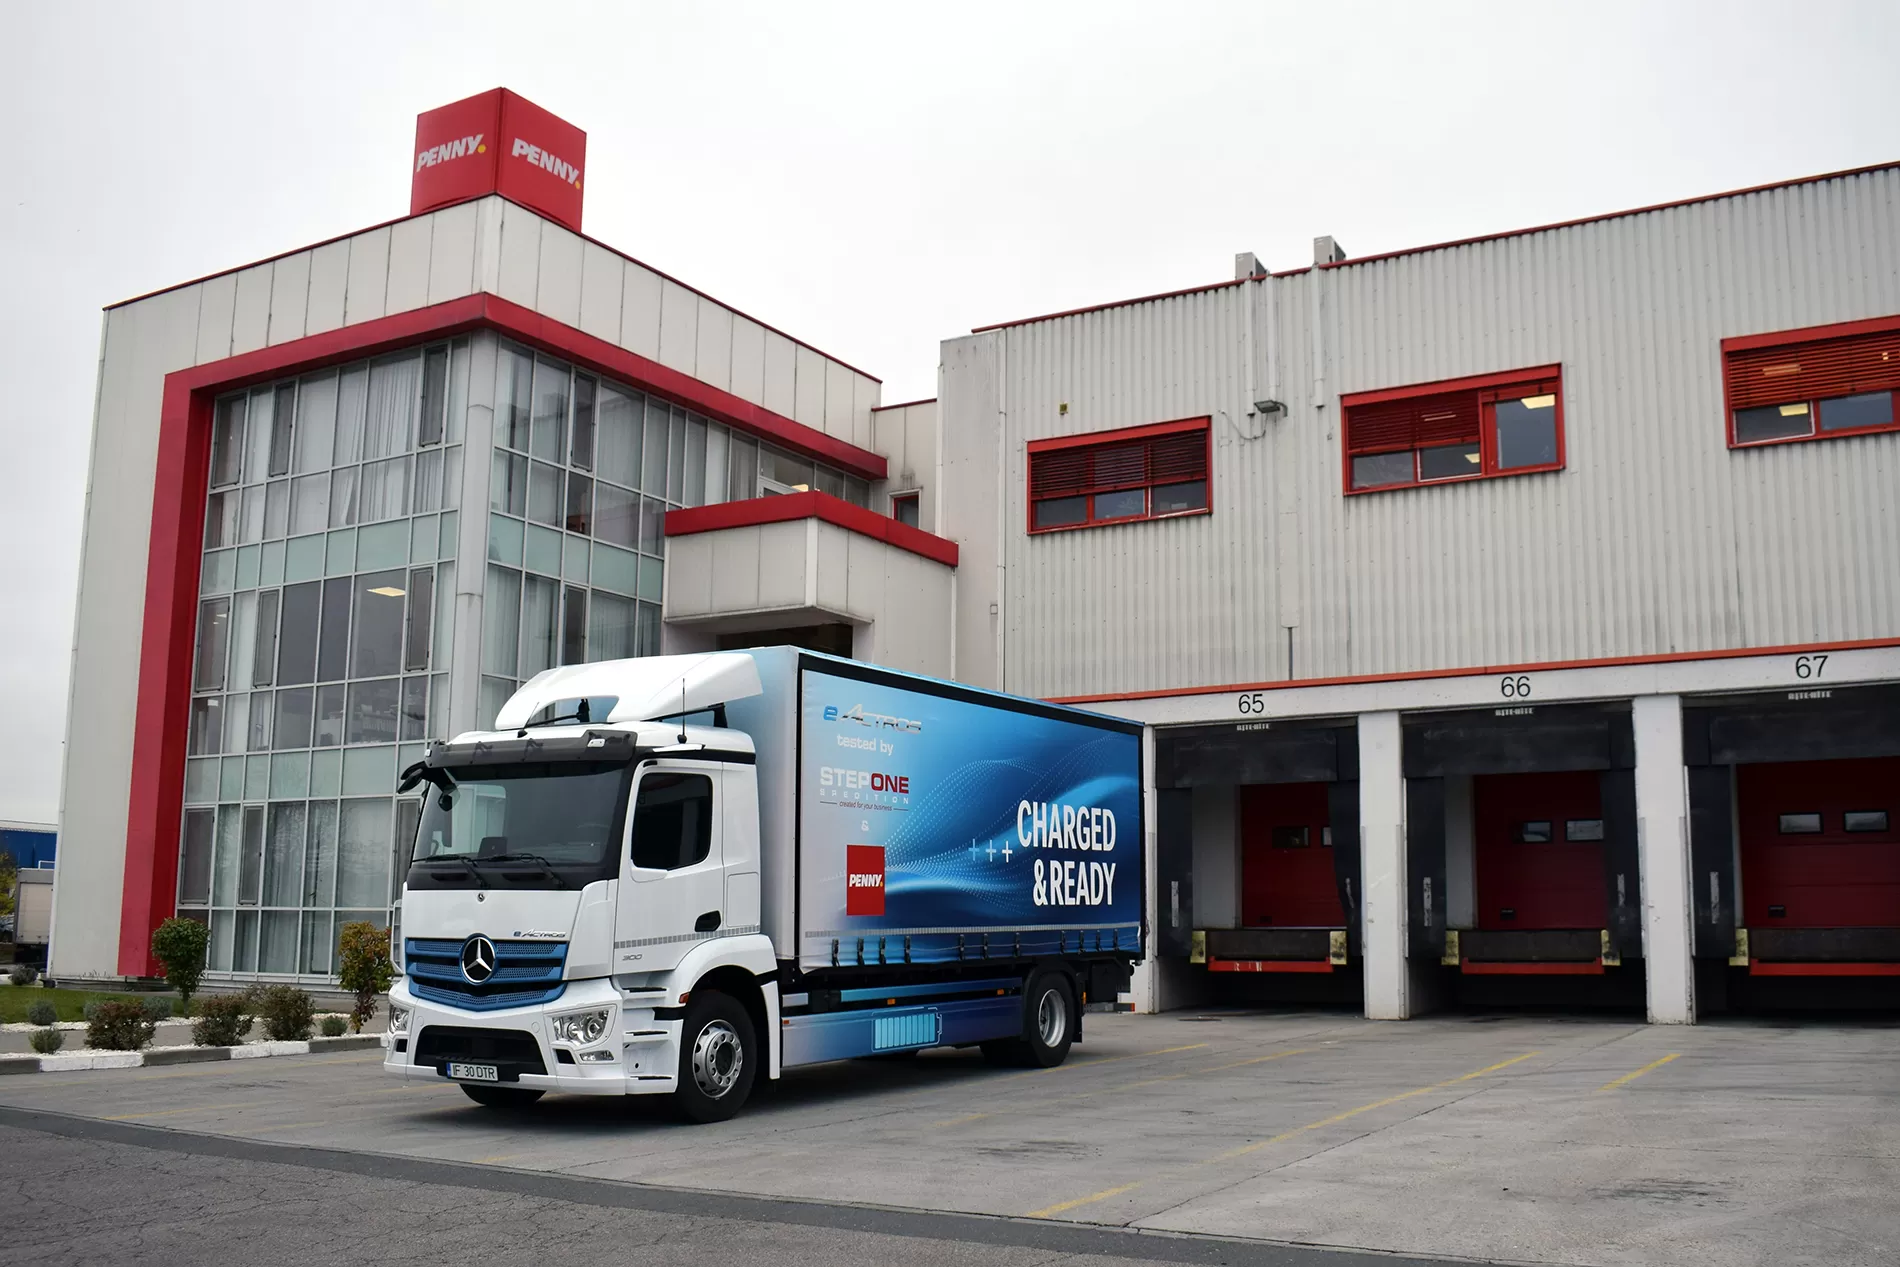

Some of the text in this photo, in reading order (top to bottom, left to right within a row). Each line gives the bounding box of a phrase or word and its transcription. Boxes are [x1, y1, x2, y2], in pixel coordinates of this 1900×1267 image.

[1795, 655, 1828, 679] 67
[1501, 675, 1531, 697] 66
[1238, 693, 1264, 714] 65
[836, 734, 894, 756] tested by
[820, 766, 909, 794] STEPONE
[863, 803, 873, 811] your
[861, 820, 869, 831] &
[1017, 799, 1116, 852] CHARGED
[452, 1064, 495, 1079] IF 30 DTR
